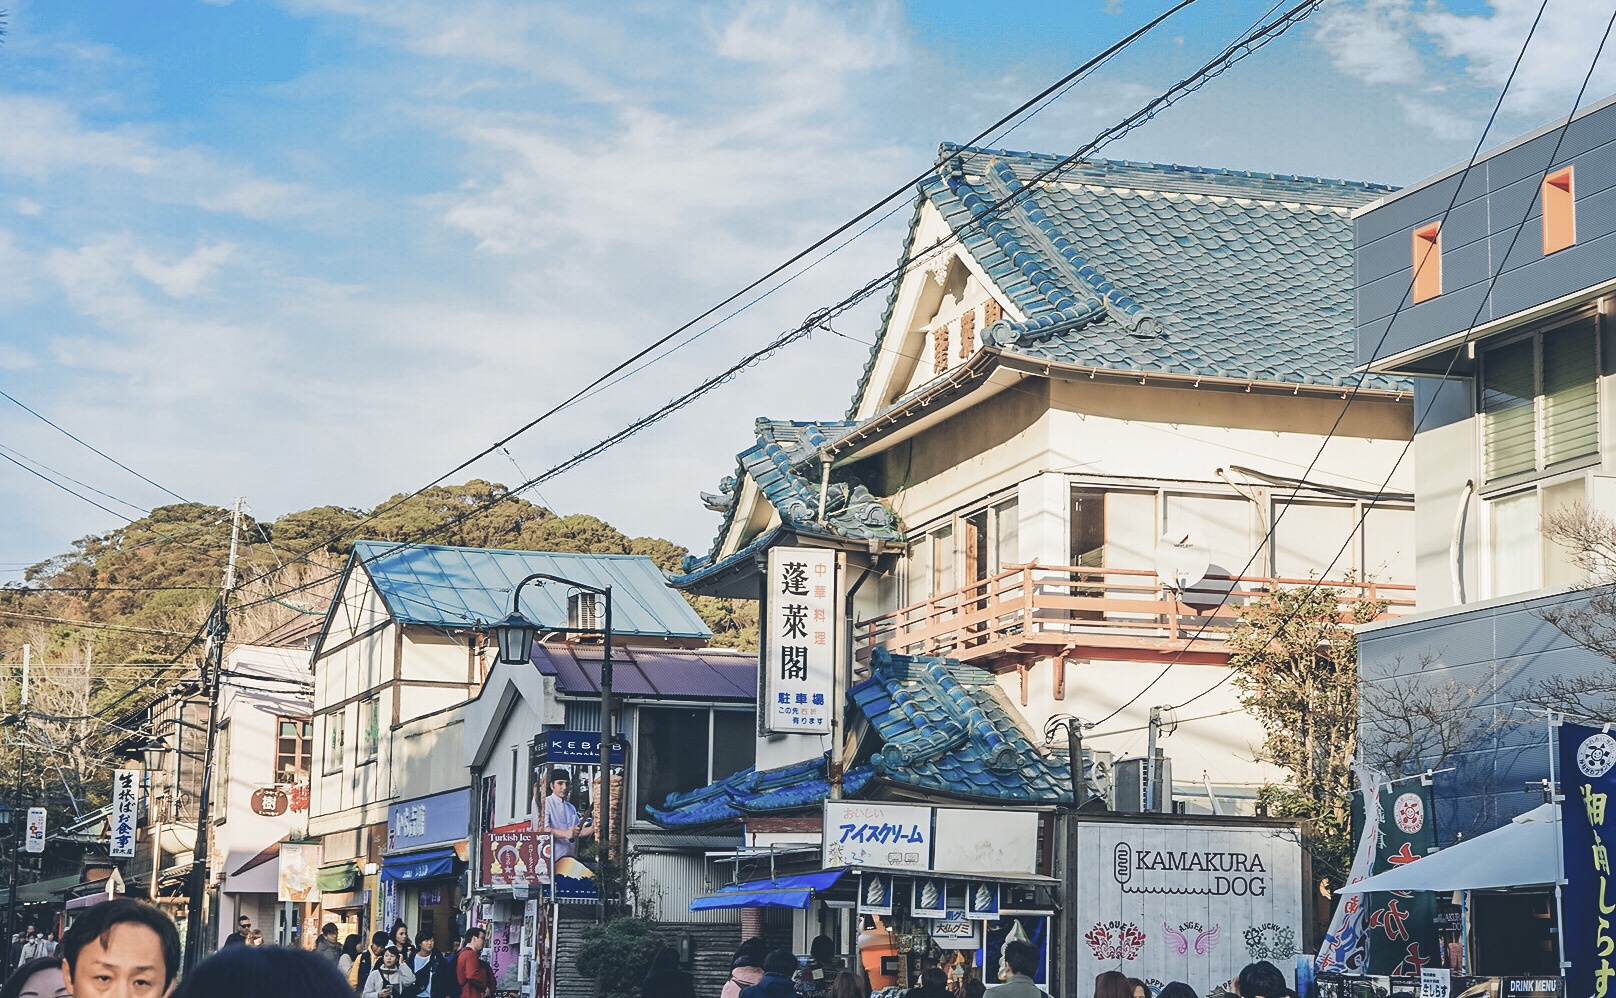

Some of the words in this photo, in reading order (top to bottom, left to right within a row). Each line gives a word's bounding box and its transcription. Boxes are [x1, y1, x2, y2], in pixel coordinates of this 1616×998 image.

[814, 562, 827, 645] 中華料理
[778, 692, 825, 706] 駐車場
[792, 716, 824, 726] 有ります
[843, 807, 884, 820] おいしい
[488, 833, 518, 842] Turkish
[520, 833, 531, 841] Ice
[839, 822, 924, 845] アイスクリーム
[1135, 850, 1266, 873] KAMAKURA
[1214, 877, 1266, 897] DOG
[936, 923, 969, 935] 大仏グミ
[1103, 920, 1128, 932] LOVE
[1178, 921, 1203, 933] ANGEL
[1257, 922, 1281, 933] LUCKY
[1145, 978, 1165, 990] APPY
[1510, 980, 1534, 992] DRINK
[1535, 980, 1557, 992] MENU
